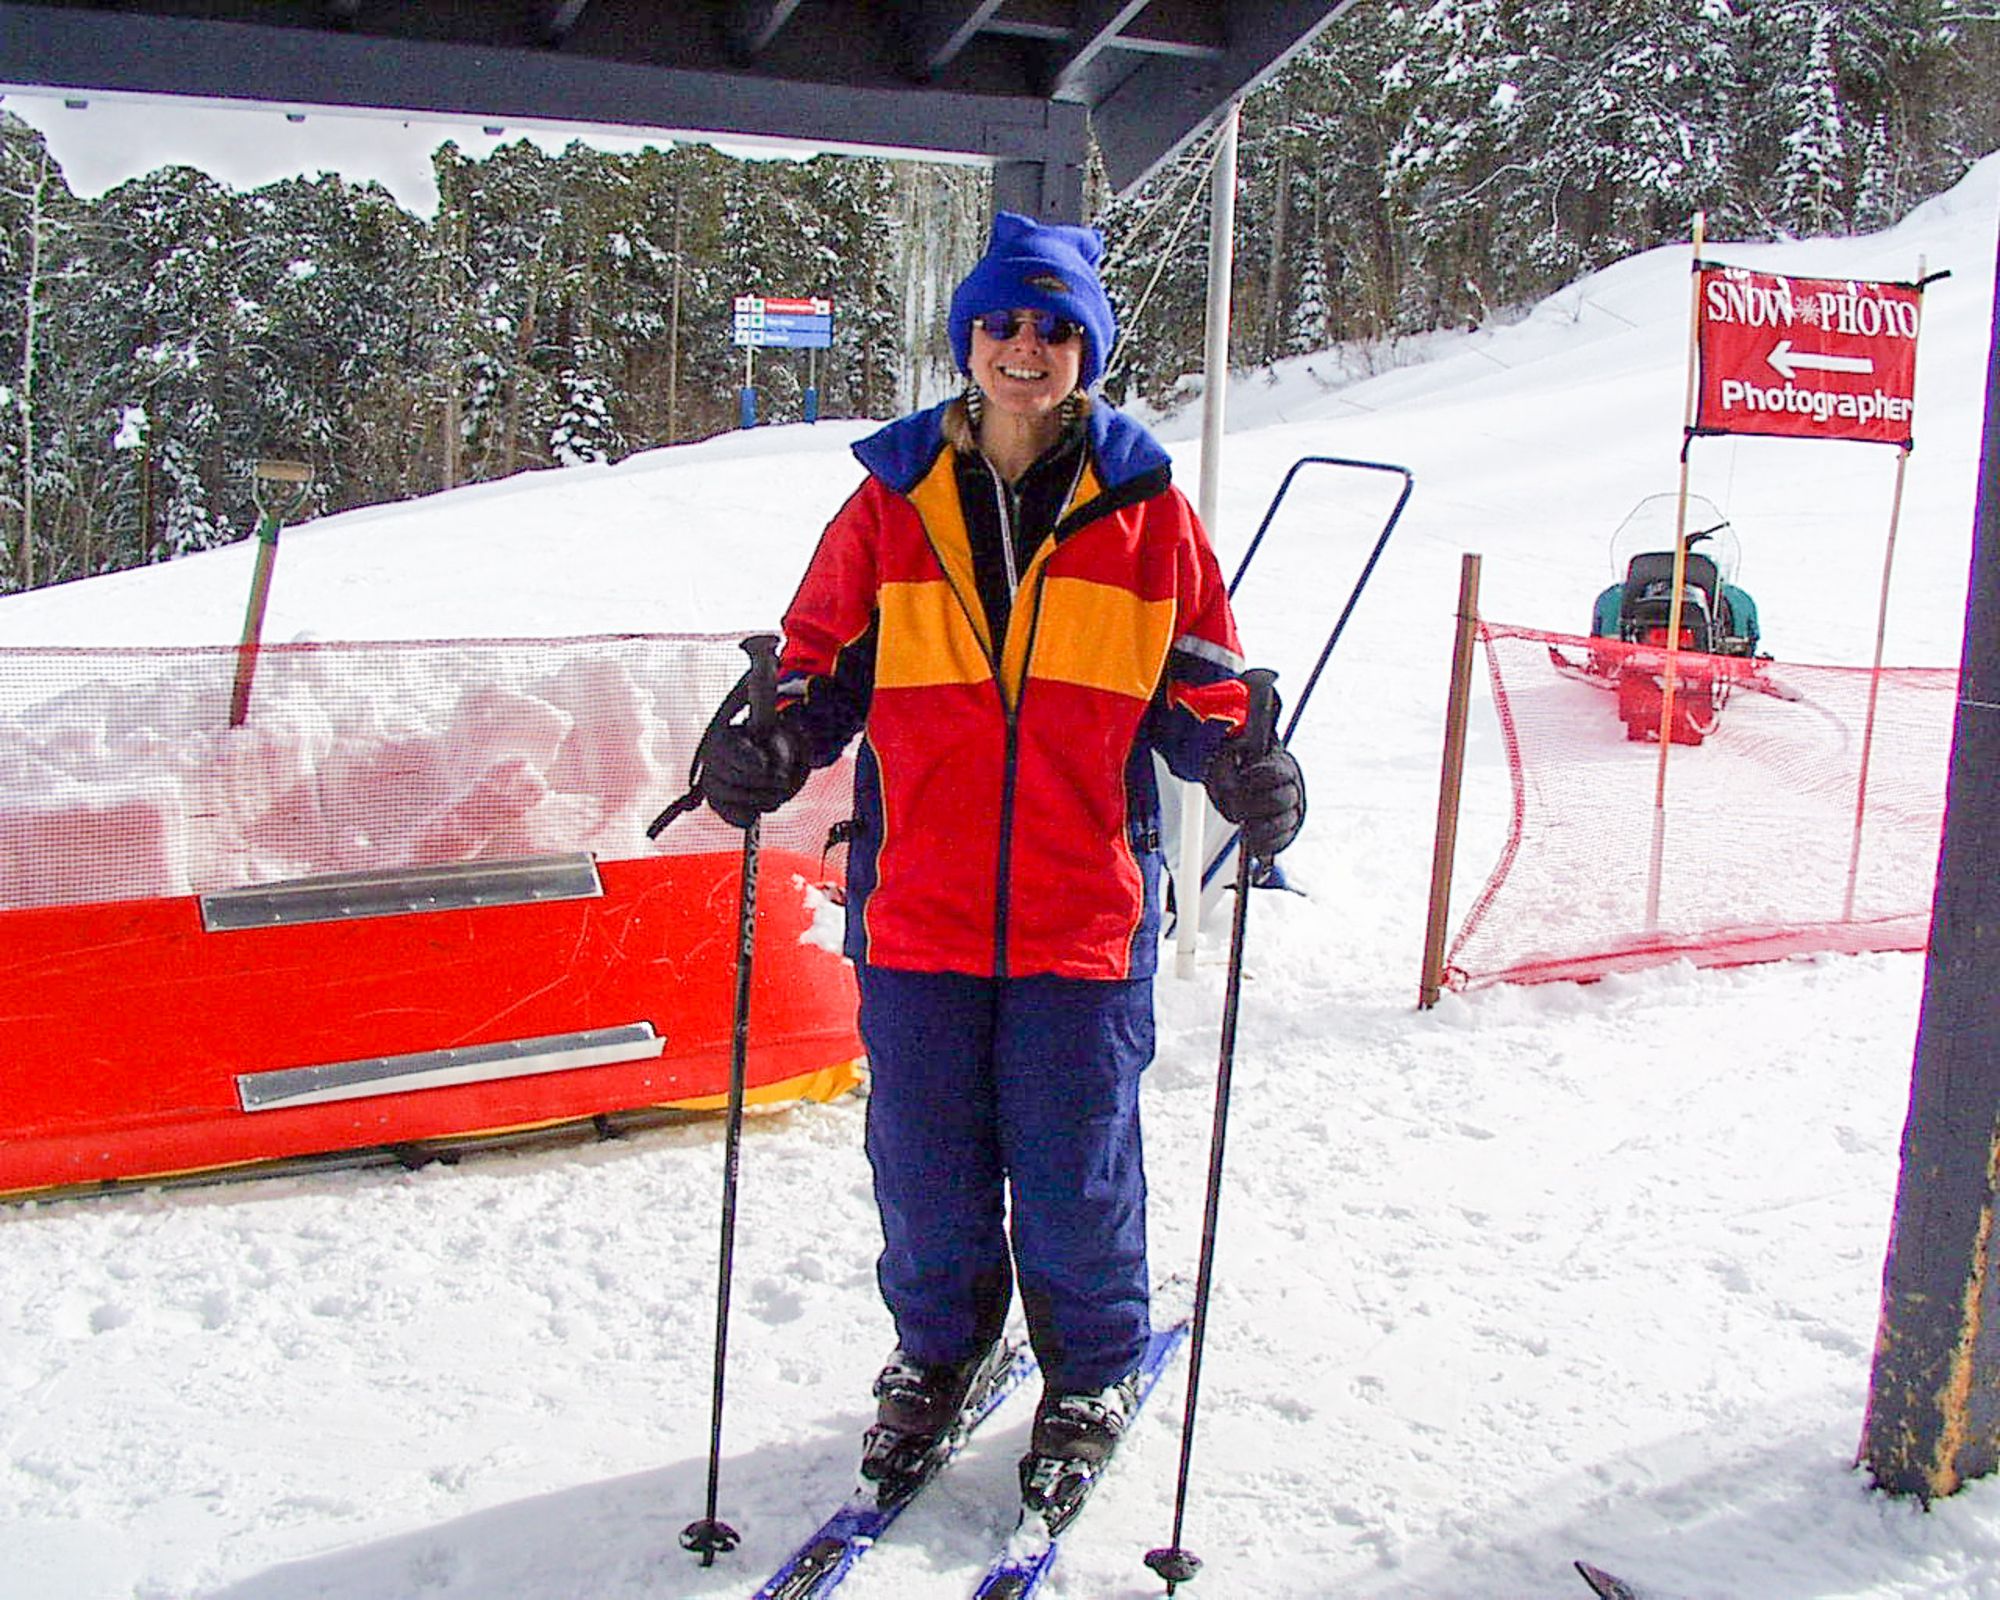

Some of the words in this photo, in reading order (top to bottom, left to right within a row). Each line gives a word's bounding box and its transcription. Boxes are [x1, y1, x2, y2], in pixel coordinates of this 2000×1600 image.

[1707, 281, 1793, 328] SNOW
[1817, 291, 1918, 339] PHOTO
[1721, 379, 1913, 423] Photographer
